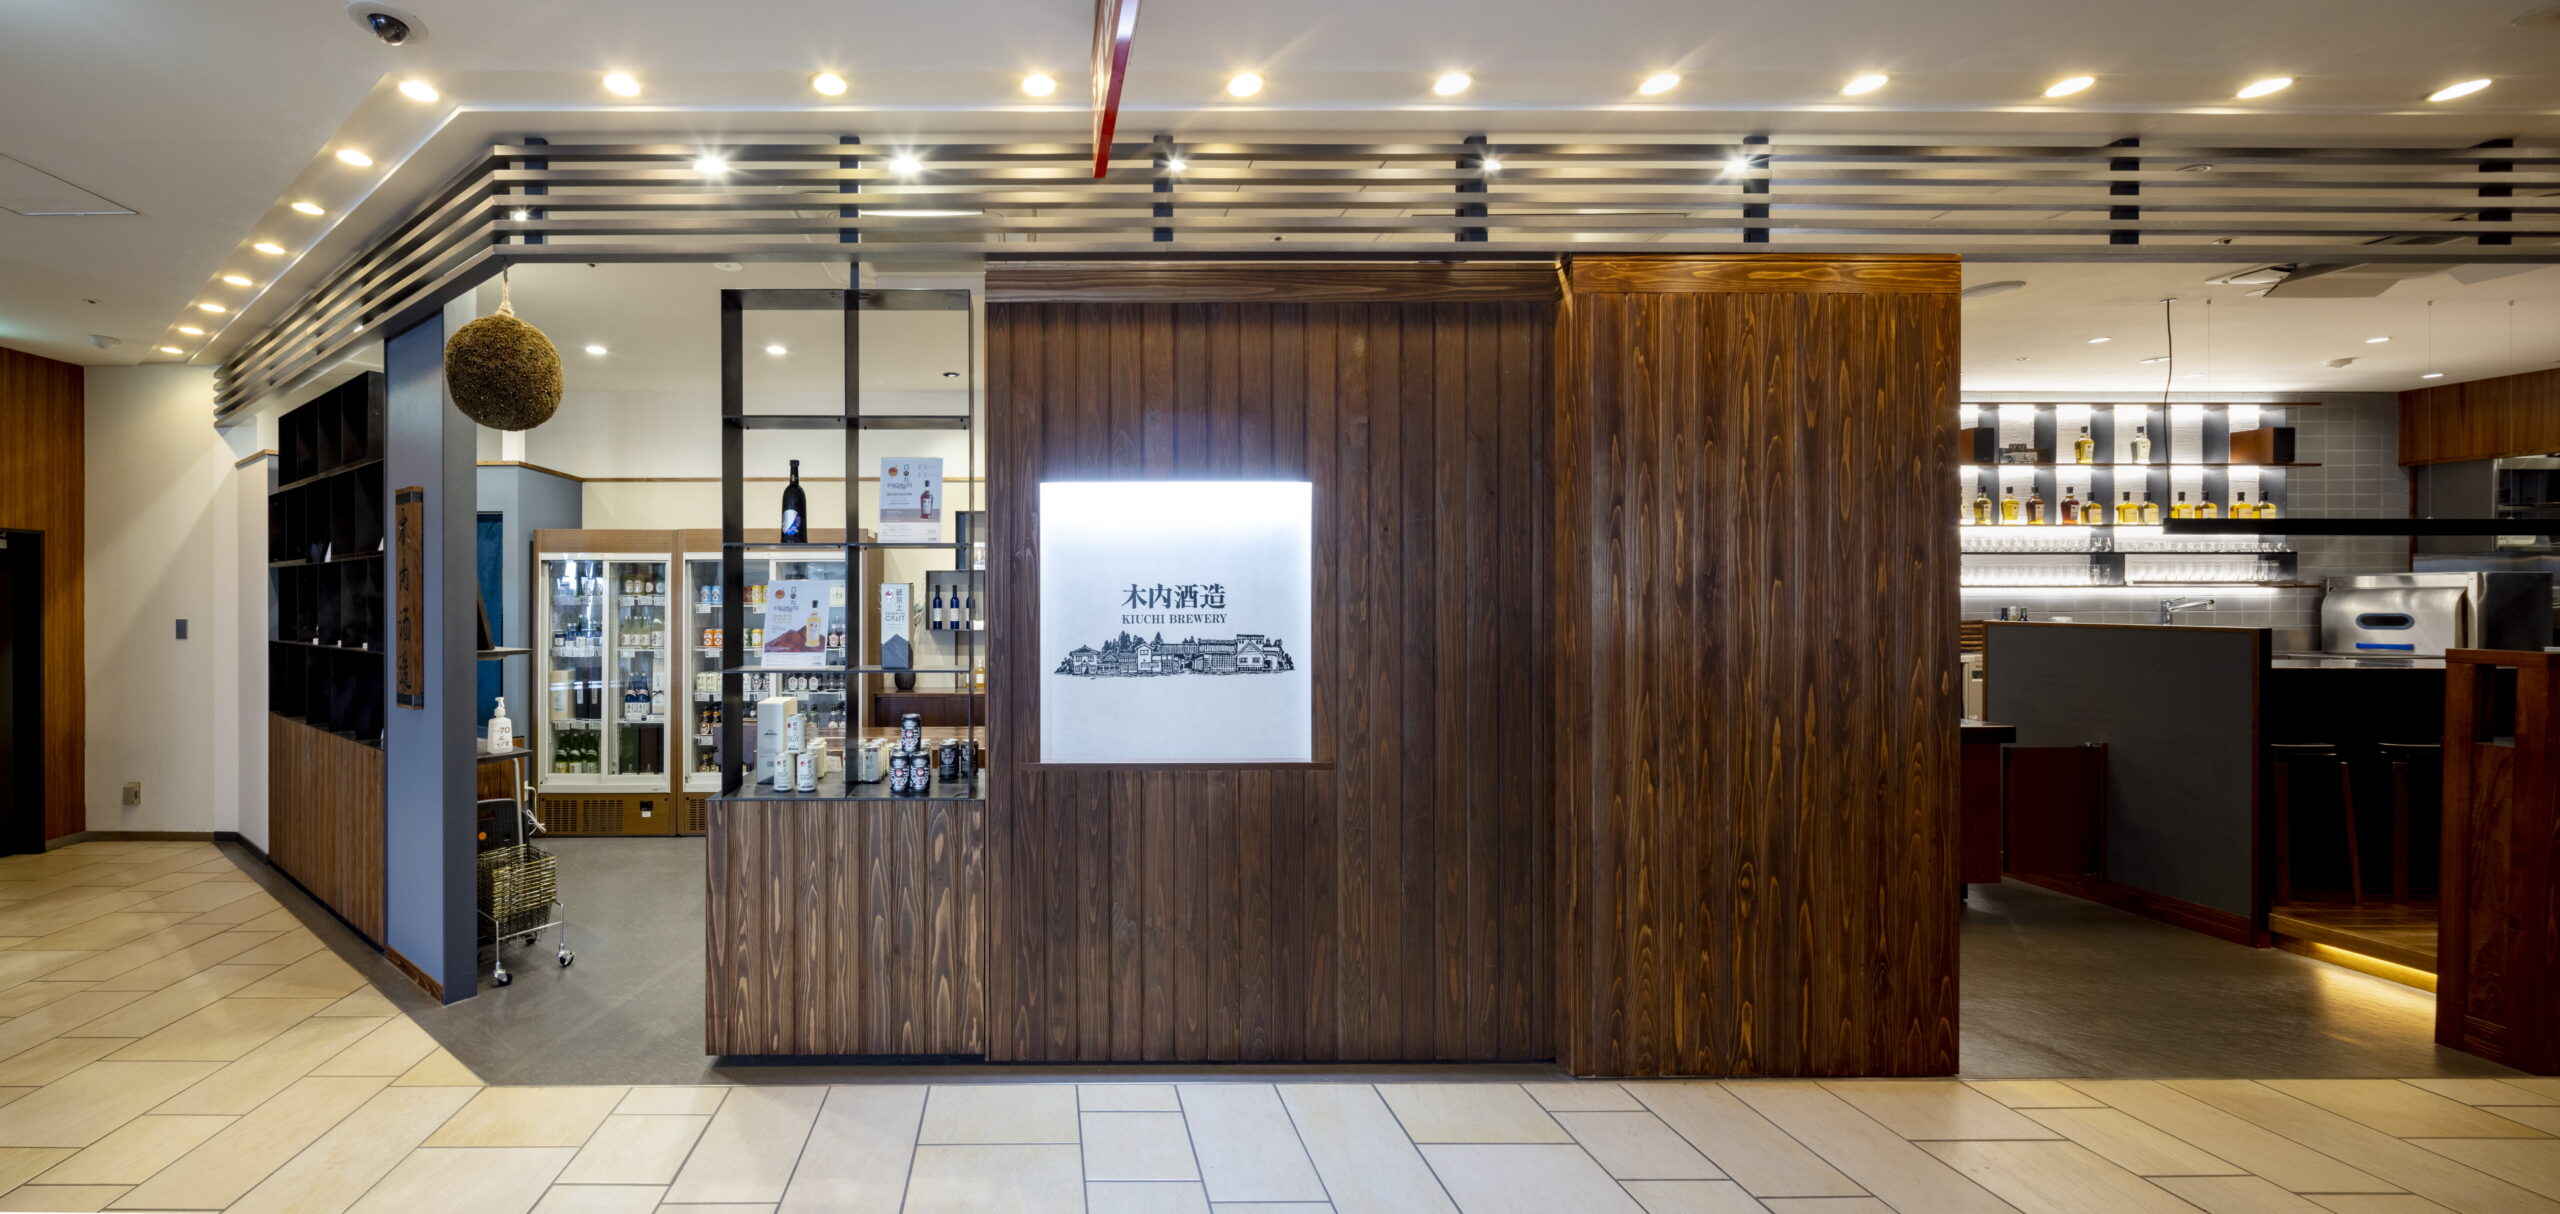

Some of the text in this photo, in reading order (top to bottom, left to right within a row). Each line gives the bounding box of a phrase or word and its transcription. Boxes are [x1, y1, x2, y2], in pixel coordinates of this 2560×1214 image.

[1121, 583, 1226, 609] 木内酒造
[1122, 613, 1228, 624] KIUCHI BREWERY
